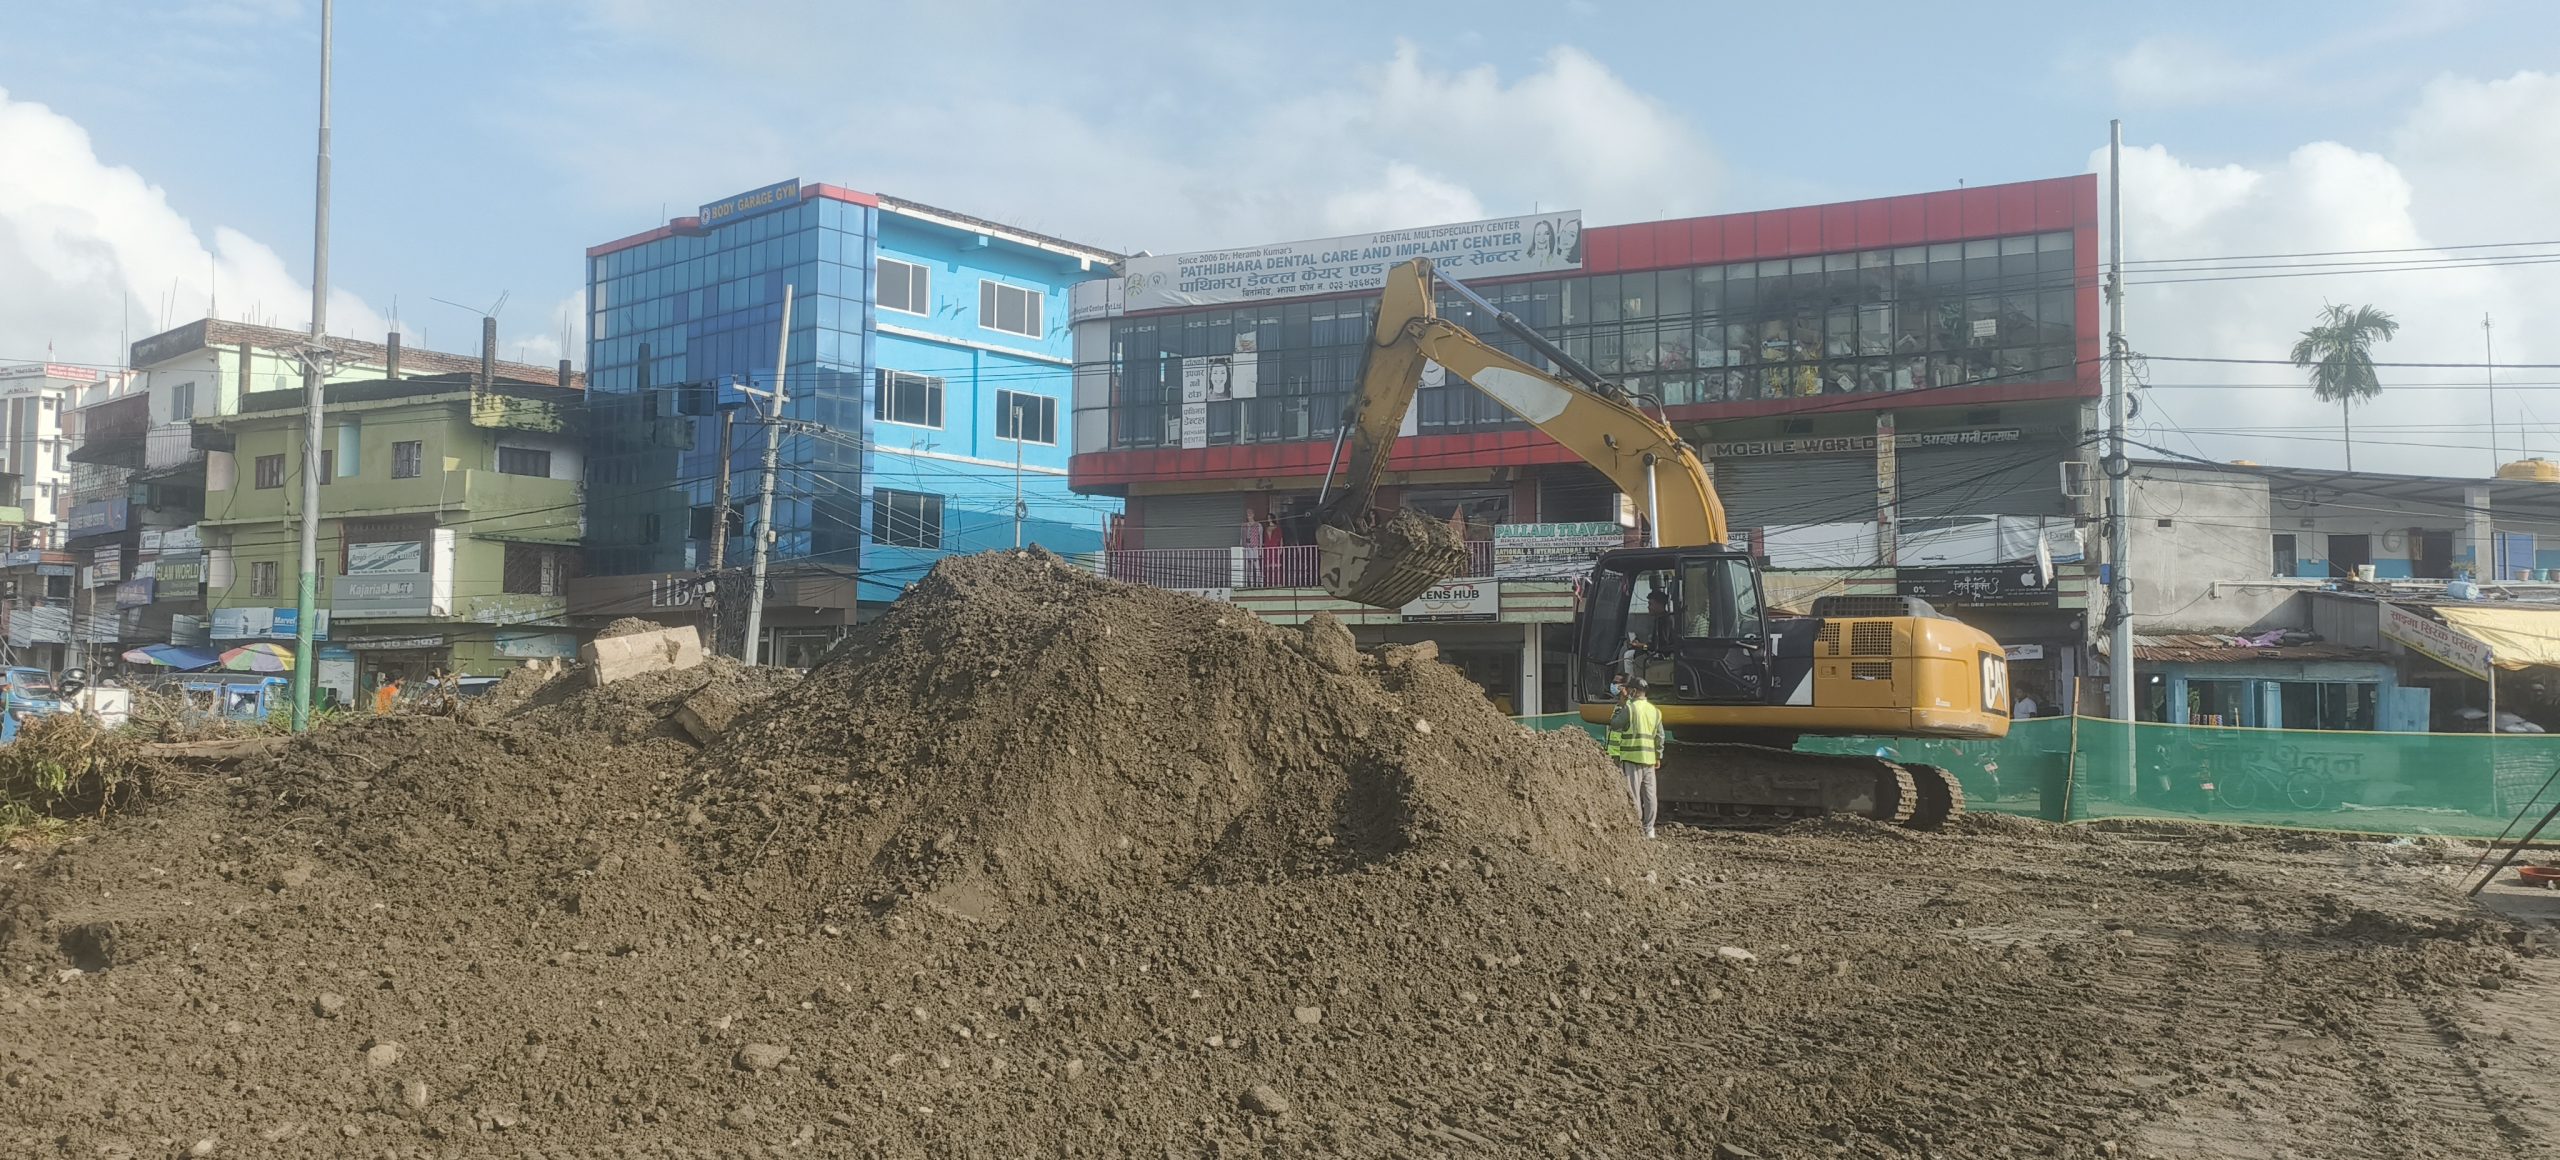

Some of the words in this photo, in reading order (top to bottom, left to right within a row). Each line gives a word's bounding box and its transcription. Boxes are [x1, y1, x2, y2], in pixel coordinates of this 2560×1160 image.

[712, 202, 734, 218] BODY
[738, 191, 773, 210] GARAGE
[776, 184, 796, 200] GYM
[1372, 236, 1378, 244] A
[1380, 233, 1411, 243] DENTAL
[1414, 225, 1485, 239] MULTISPECIALITY
[1487, 221, 1520, 231] CENTER
[1178, 257, 1198, 265] Since
[1200, 254, 1217, 263] 2006
[1219, 253, 1230, 261] Dr.
[1233, 249, 1262, 259] Heramb
[1263, 247, 1292, 256] Kumar's
[1180, 259, 1262, 278] PATHIBHARA
[1267, 254, 1317, 269] DENTAL
[1322, 249, 1358, 263] CARE
[1363, 246, 1391, 259] AND
[1396, 239, 1458, 256] IMPLANT
[1463, 232, 1522, 249] CENTER
[1179, 277, 1242, 293] पाथिभरा
[1247, 271, 1297, 286] डेन्टल
[1302, 266, 1344, 281] केयर
[1349, 263, 1384, 276] एण्ड
[1469, 249, 1523, 265] सेन्टर
[1716, 441, 1795, 456] MOBILE
[1800, 436, 1878, 453] WORLD
[1558, 522, 1625, 536] TRAVELS
[1534, 547, 1582, 555] INTERNATIONAL
[156, 565, 174, 581] GLAM
[175, 563, 199, 579] WORLD
[349, 583, 381, 598] Kajaria
[651, 574, 705, 608] LIBA
[1420, 590, 1451, 600] LENS
[1453, 589, 1480, 599] HUB
[1914, 586, 1926, 594] 0%
[214, 617, 238, 626] Marvel
[274, 616, 296, 626] Marvel
[1743, 633, 1783, 657] CT
[1983, 656, 2007, 709] CAT
